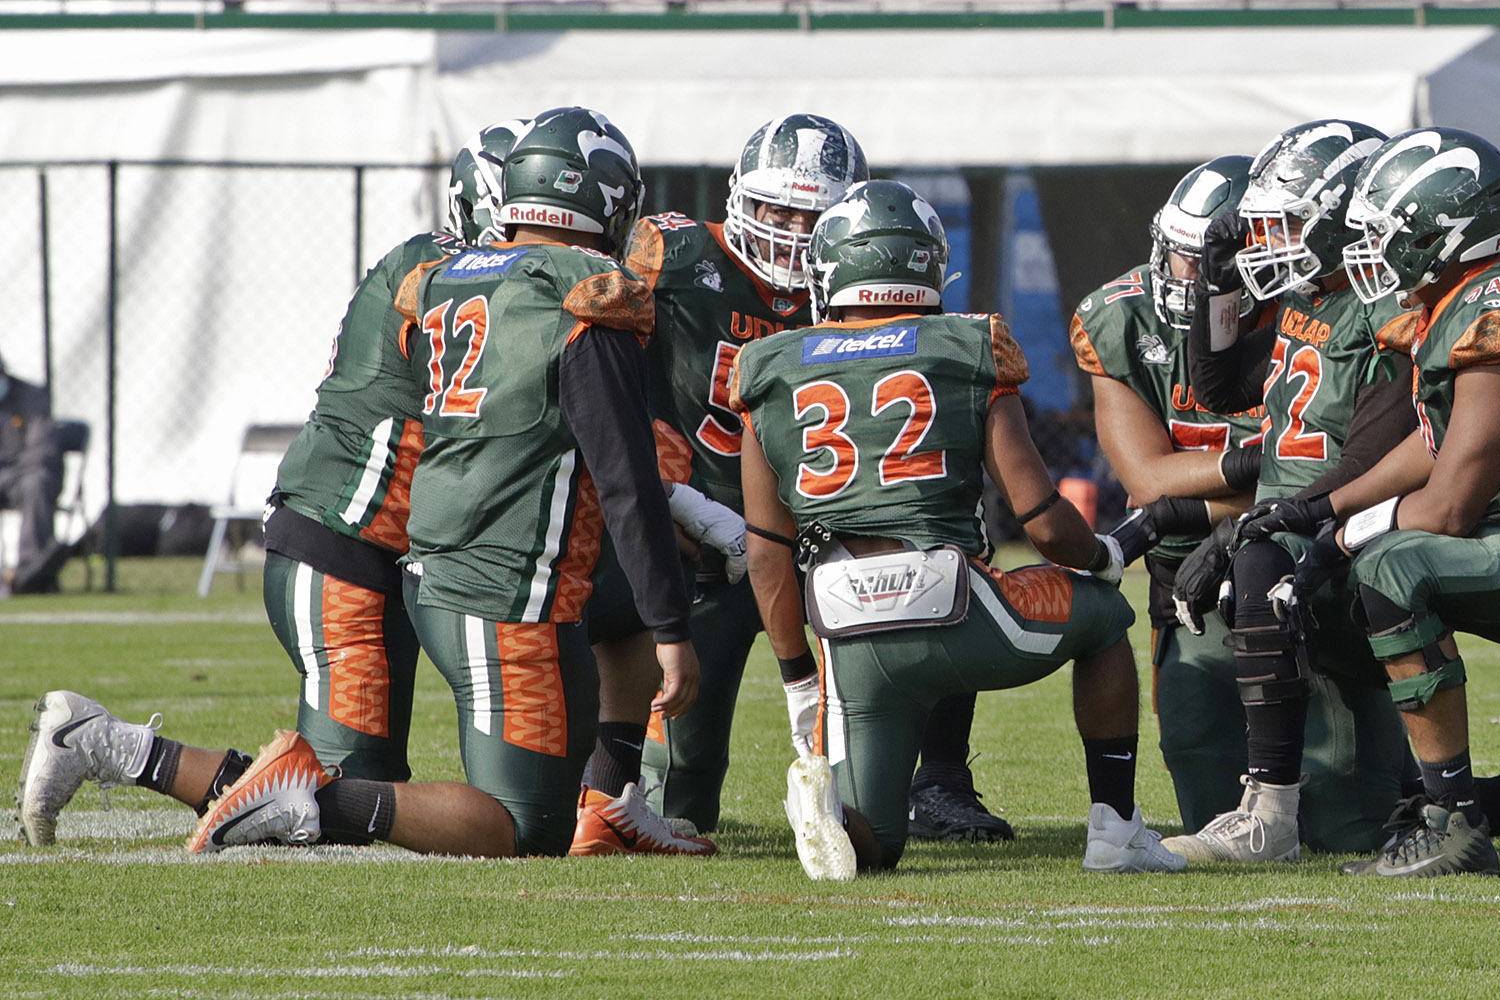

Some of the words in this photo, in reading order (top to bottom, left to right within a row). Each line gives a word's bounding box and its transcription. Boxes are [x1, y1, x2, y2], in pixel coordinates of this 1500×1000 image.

[792, 181, 820, 194] Riddell
[510, 206, 573, 227] Riddell
[858, 288, 927, 304] Riddell
[1102, 271, 1146, 305] 71
[422, 294, 490, 418] 12
[837, 330, 905, 354] telcel
[1262, 334, 1329, 462] 72
[793, 369, 948, 500] 32
